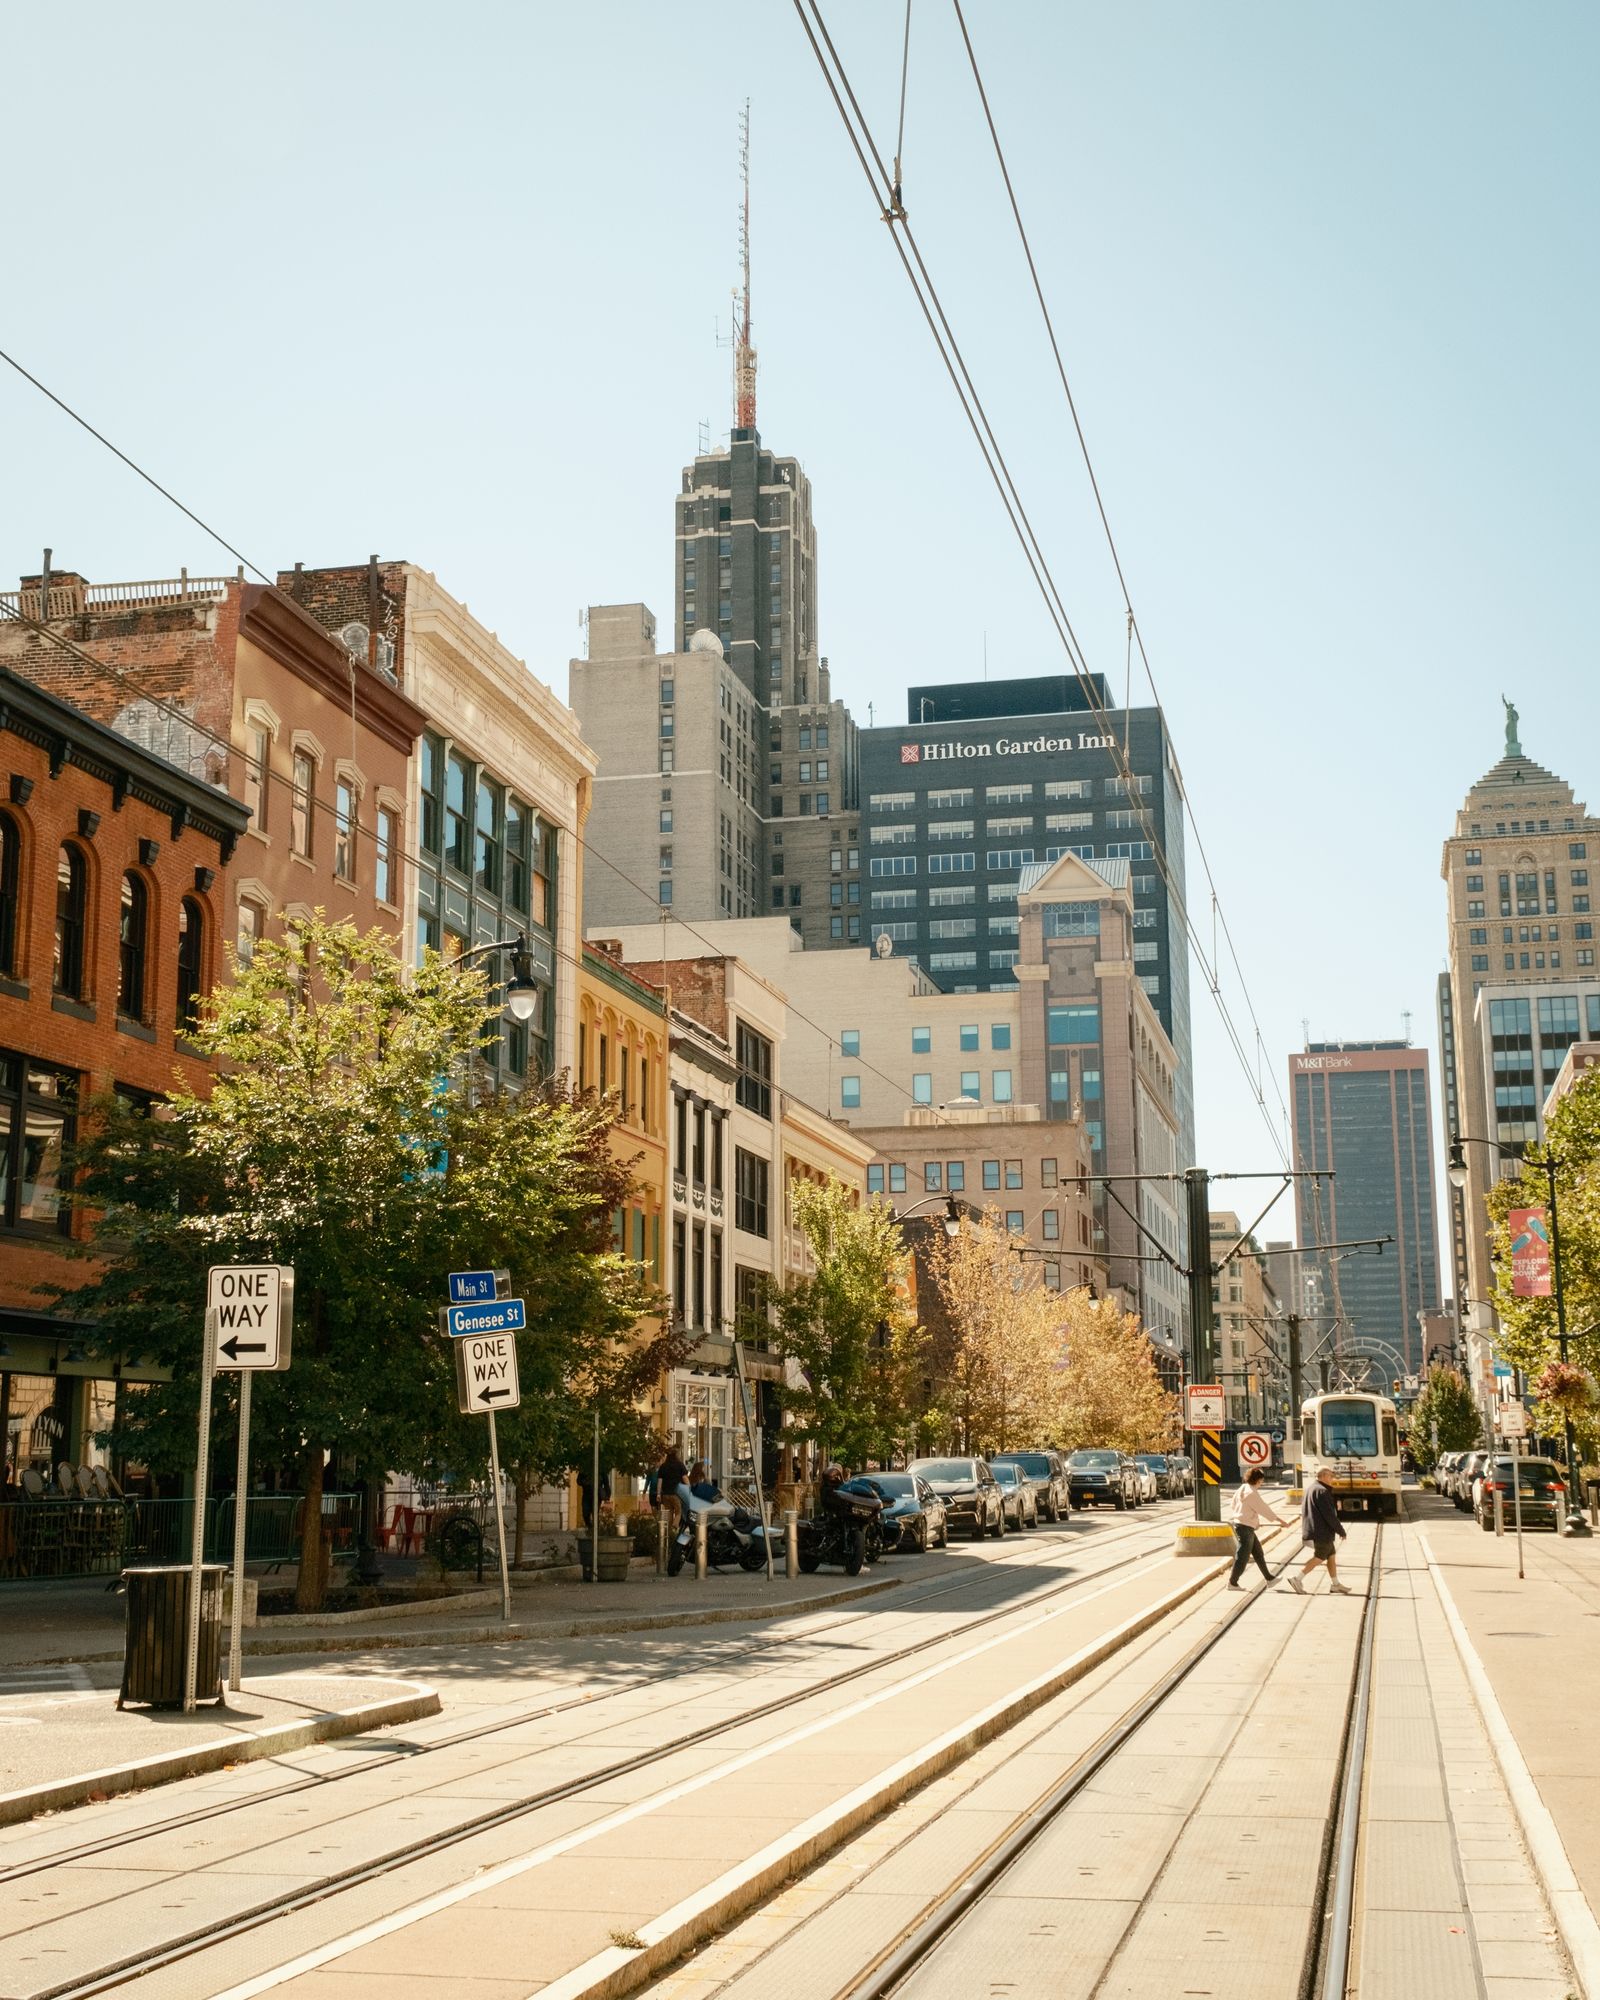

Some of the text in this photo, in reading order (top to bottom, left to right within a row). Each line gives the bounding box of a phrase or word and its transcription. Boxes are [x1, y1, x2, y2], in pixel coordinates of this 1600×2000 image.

[922, 732, 1116, 761] Hilton Garden Inn
[1296, 1056, 1353, 1069] M&T Bank
[1512, 1257, 1548, 1265] EXPLORE
[220, 1274, 268, 1298] ONE
[456, 1278, 488, 1298] Main St
[219, 1304, 268, 1328] WAY
[454, 1308, 519, 1332] Genesee St
[472, 1339, 507, 1360] ONE
[473, 1361, 508, 1382] WAY
